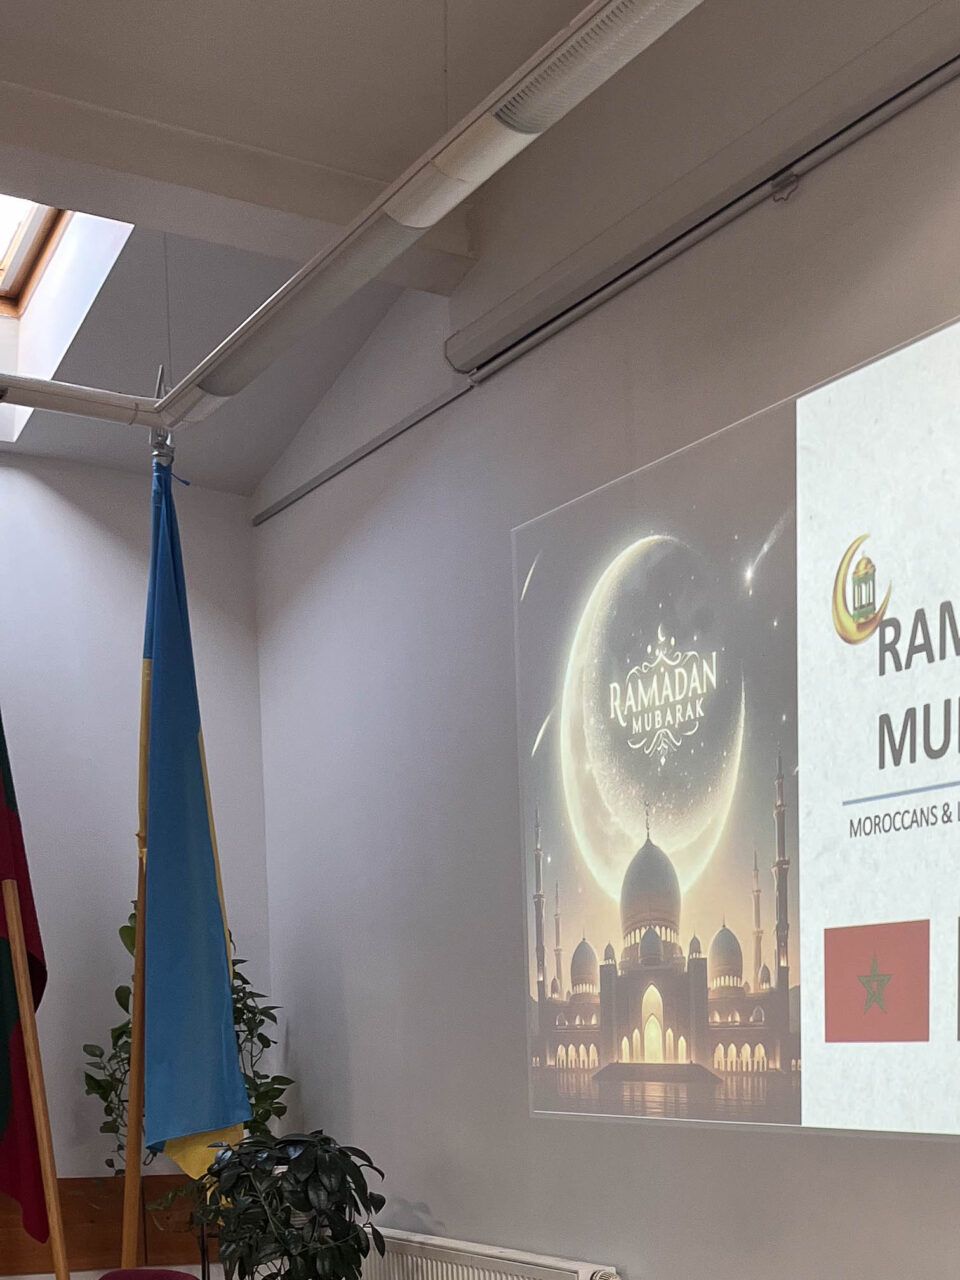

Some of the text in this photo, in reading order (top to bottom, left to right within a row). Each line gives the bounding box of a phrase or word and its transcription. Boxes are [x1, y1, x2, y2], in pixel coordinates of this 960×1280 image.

[609, 651, 717, 727] RAMADAN
[632, 697, 705, 734] MUBARAK
[849, 805, 938, 838] MOROCCANS
[941, 802, 953, 824] &
